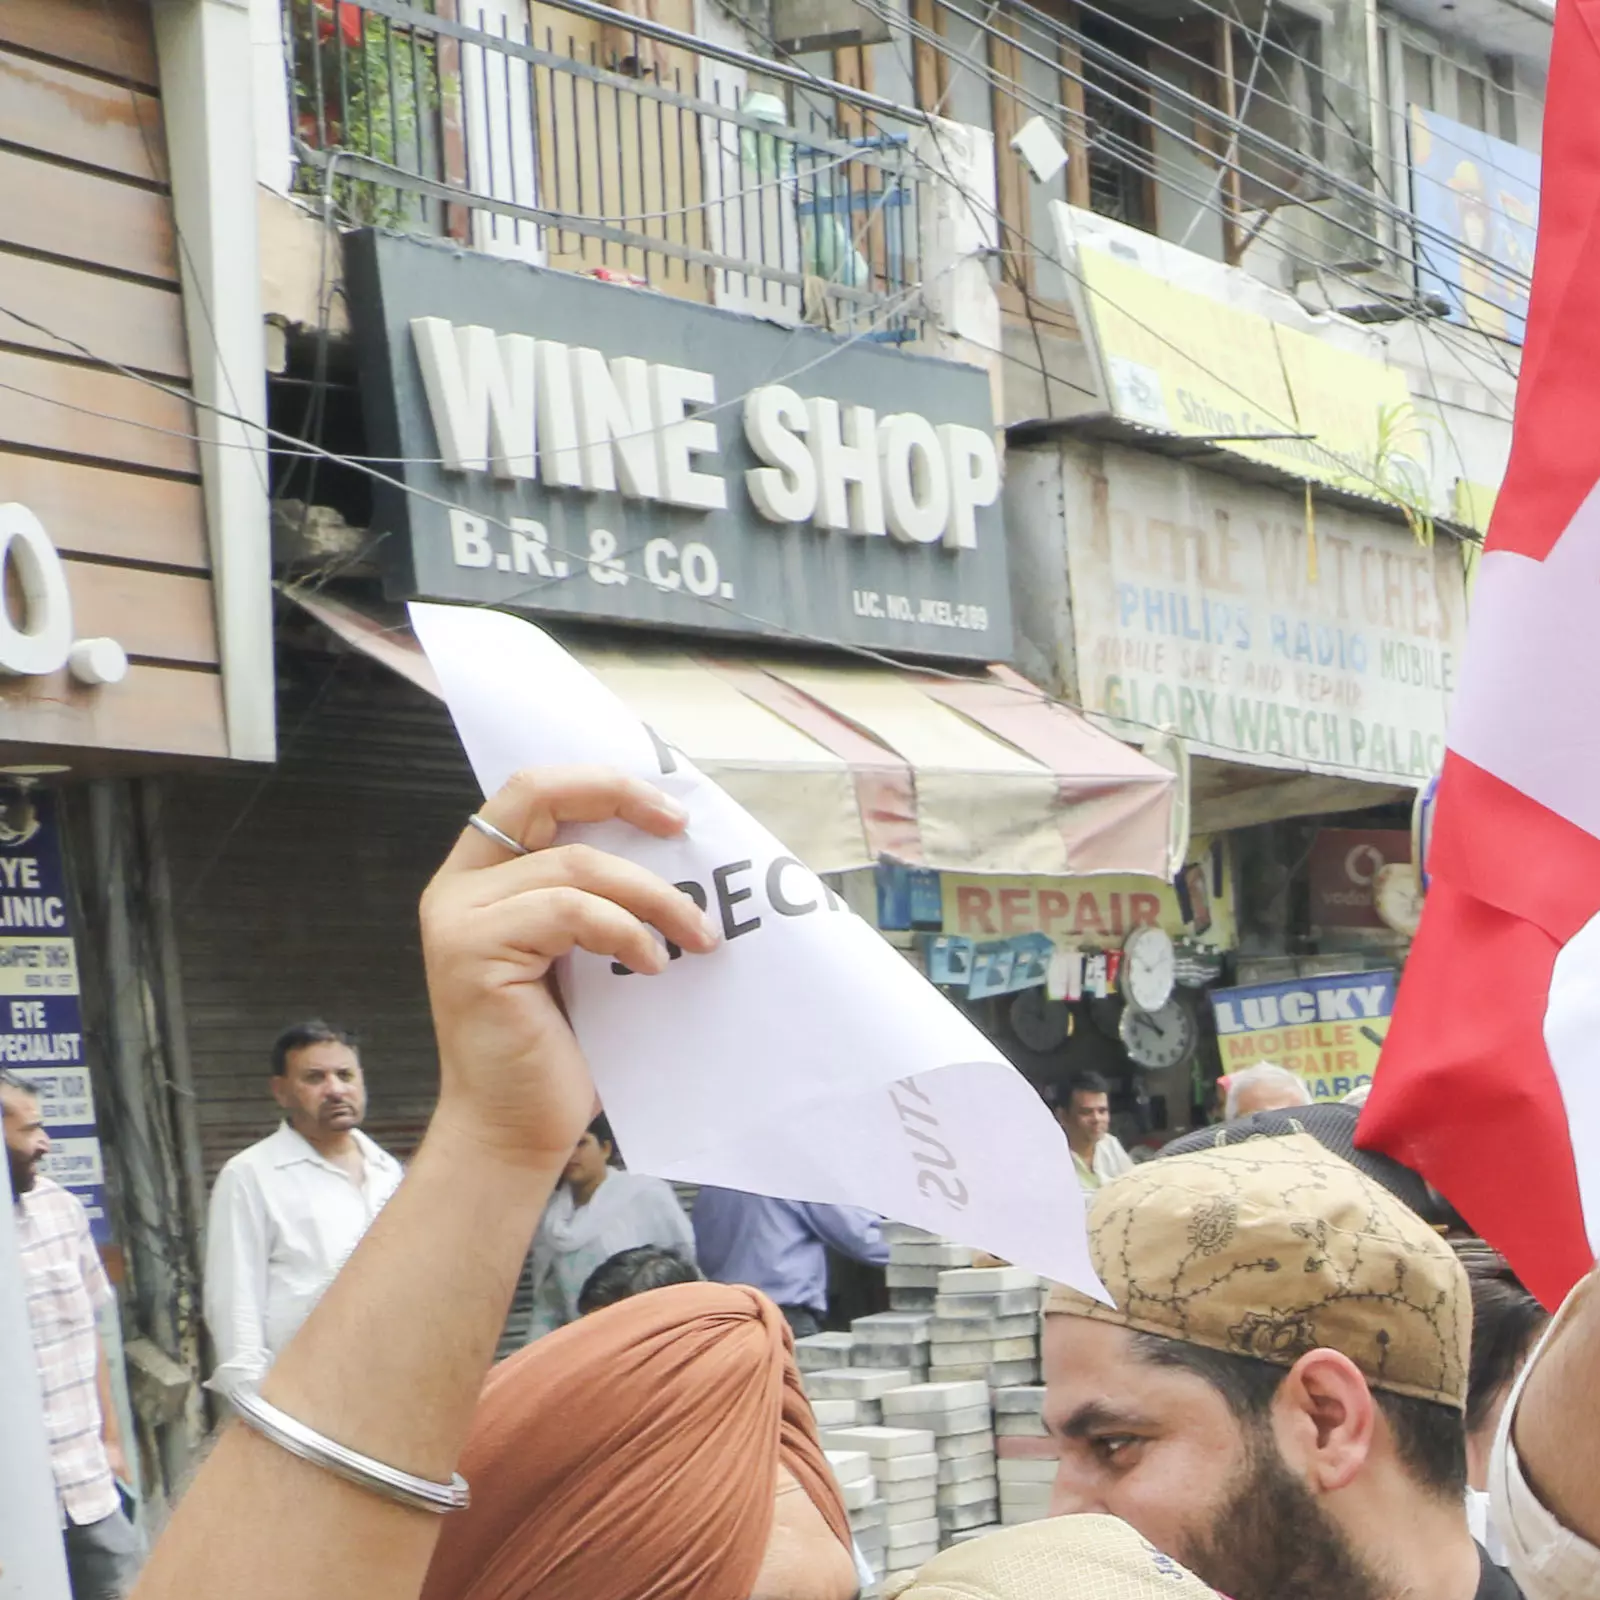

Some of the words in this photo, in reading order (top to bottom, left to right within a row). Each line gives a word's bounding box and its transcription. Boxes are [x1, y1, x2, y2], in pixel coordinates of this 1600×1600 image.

[409, 316, 727, 510] WINE
[744, 384, 1000, 550] SHOP
[450, 509, 569, 577] B.R.
[587, 528, 627, 586] &
[644, 538, 734, 600] CO.
[1118, 582, 1250, 649] PHILIPS
[1270, 612, 1368, 673] RADIO
[1380, 638, 1454, 692] MOBILE
[1104, 673, 1216, 743] GLORY
[1230, 694, 1339, 761] WATCH
[0, 857, 40, 889] YE
[956, 885, 1161, 936] REPAIR
[10, 1001, 47, 1029] EYE
[1215, 984, 1387, 1032] LUCKY
[1228, 1024, 1354, 1058] MOBILE
